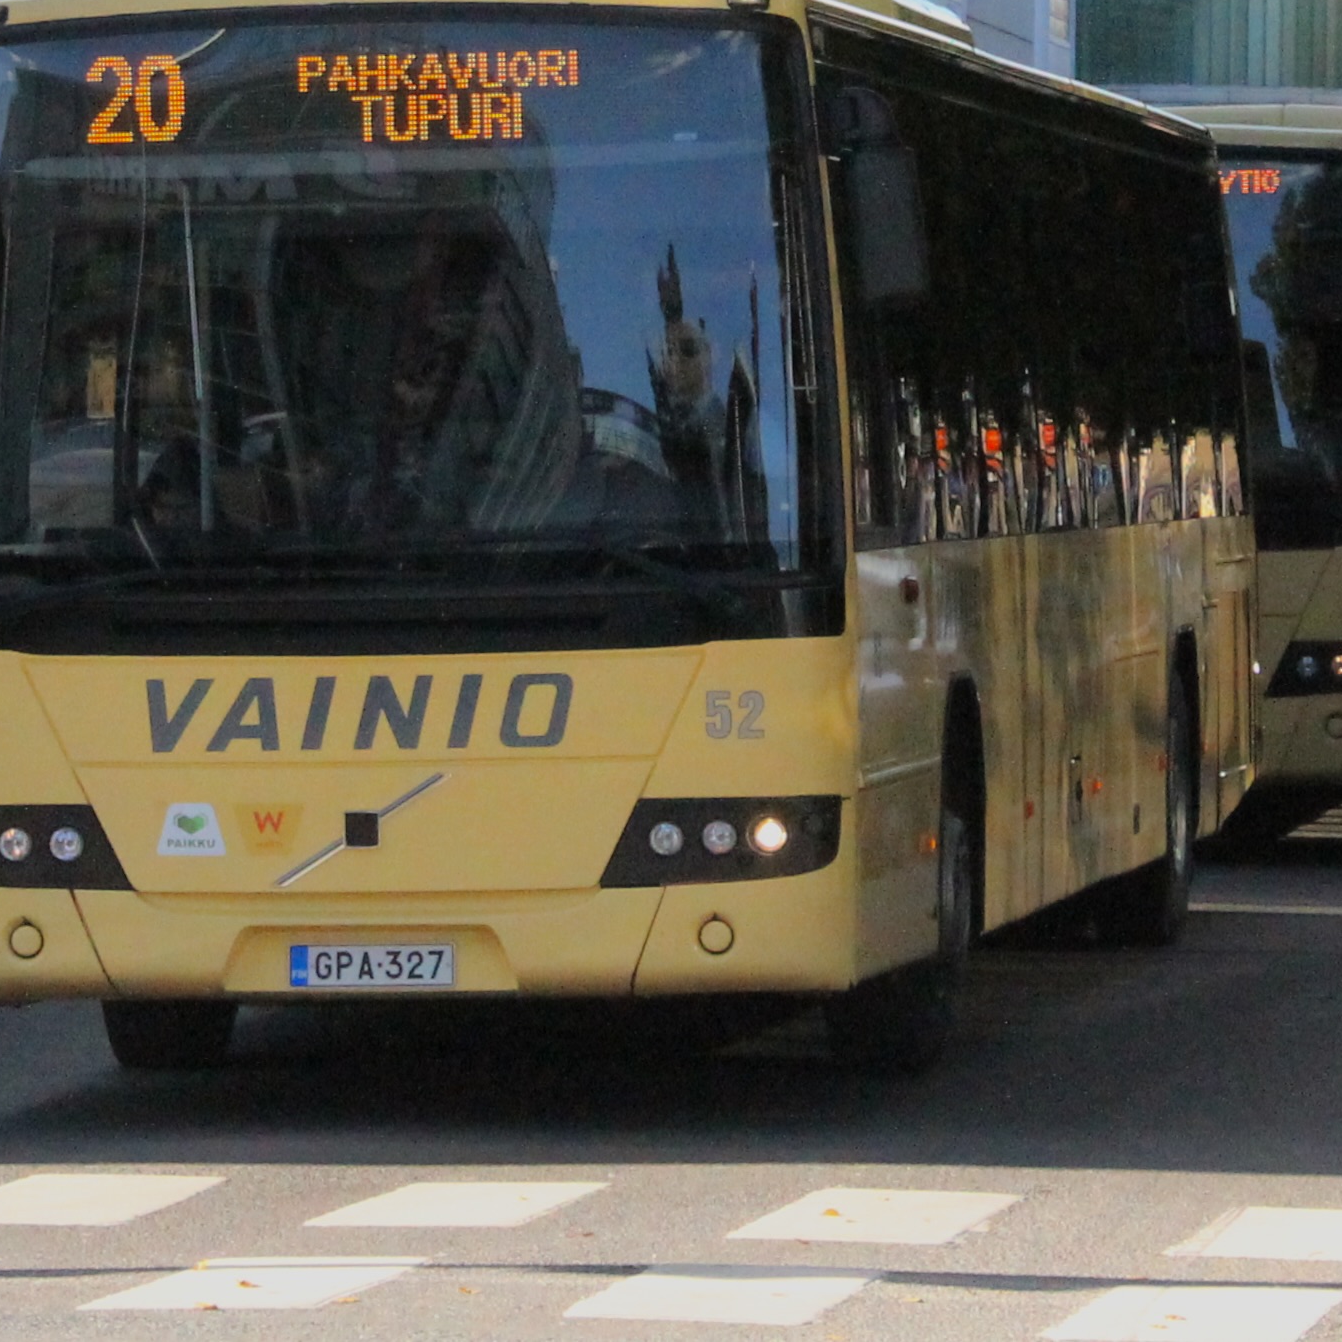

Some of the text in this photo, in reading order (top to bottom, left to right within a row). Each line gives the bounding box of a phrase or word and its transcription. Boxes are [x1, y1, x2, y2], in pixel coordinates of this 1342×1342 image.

[297, 49, 580, 93] PAHKAVUORI
[87, 54, 187, 144] 20
[351, 92, 525, 144] TUPURI
[145, 672, 574, 753] VAINIO
[704, 689, 765, 739] 52
[167, 838, 216, 849] PAIKKU
[254, 811, 284, 834] W
[314, 950, 444, 980] GPA-327
